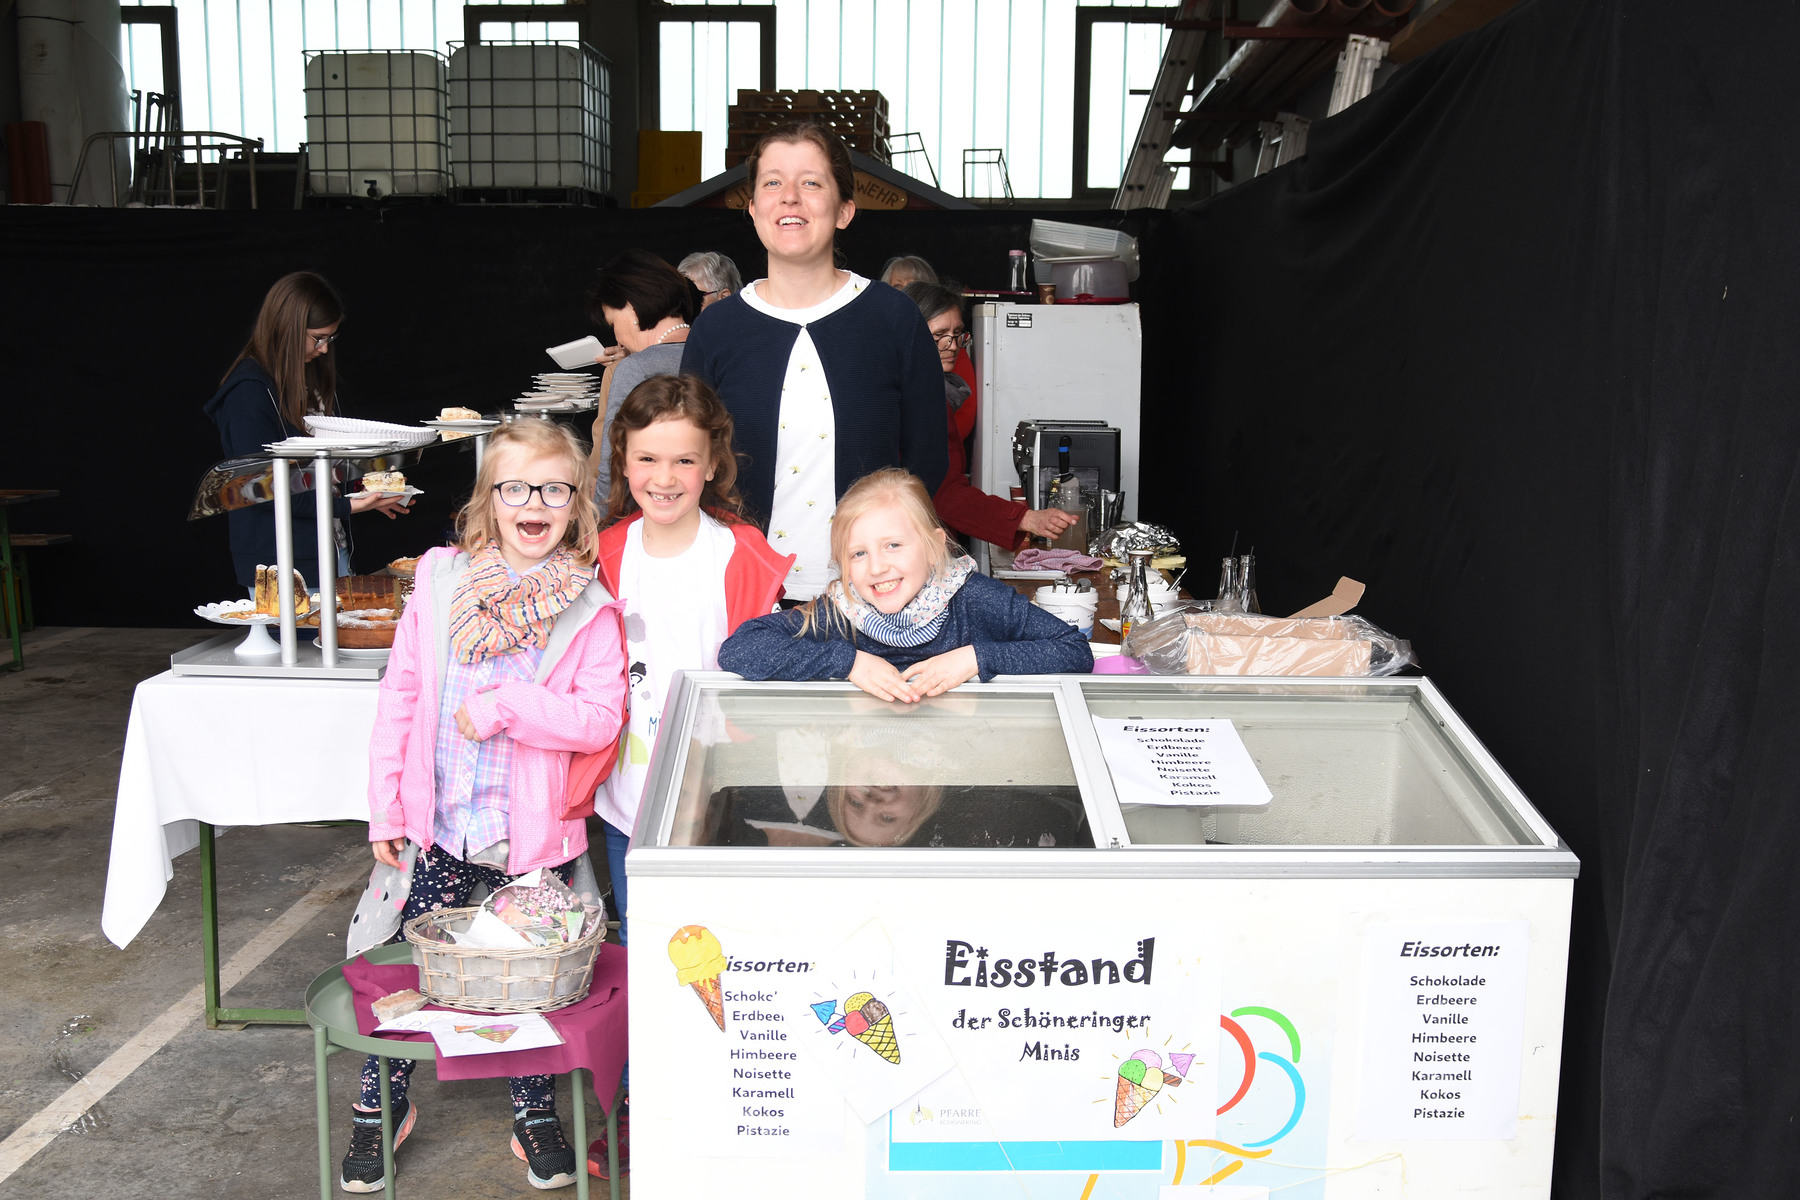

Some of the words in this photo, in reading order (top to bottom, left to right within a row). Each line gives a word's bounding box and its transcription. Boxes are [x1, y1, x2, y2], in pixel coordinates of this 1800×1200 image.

[1123, 725, 1210, 733] Eissorten:
[1399, 940, 1501, 958] Eissorten:
[944, 936, 1156, 989] Eisstand
[1409, 974, 1486, 987] Schokolade
[1416, 994, 1478, 1006] Erdbeere
[952, 1008, 993, 1031] der
[997, 1007, 1152, 1031] Schöneringer
[1422, 1013, 1469, 1025] Vanille
[739, 1029, 788, 1041] Vanille
[1411, 1031, 1477, 1044] Himbeere
[730, 1048, 797, 1061] Himbeere
[1018, 1040, 1081, 1063] Minis
[1413, 1050, 1471, 1063] Noisette
[732, 1067, 792, 1080] Noisette
[1411, 1069, 1472, 1081] Karamell
[732, 1087, 795, 1099] Karamell
[1420, 1088, 1461, 1100] Kokos
[742, 1106, 785, 1118] Kokos
[939, 1108, 982, 1118] PFARRE
[1413, 1107, 1465, 1119] Pistazie
[737, 1124, 790, 1136] Pistazie
